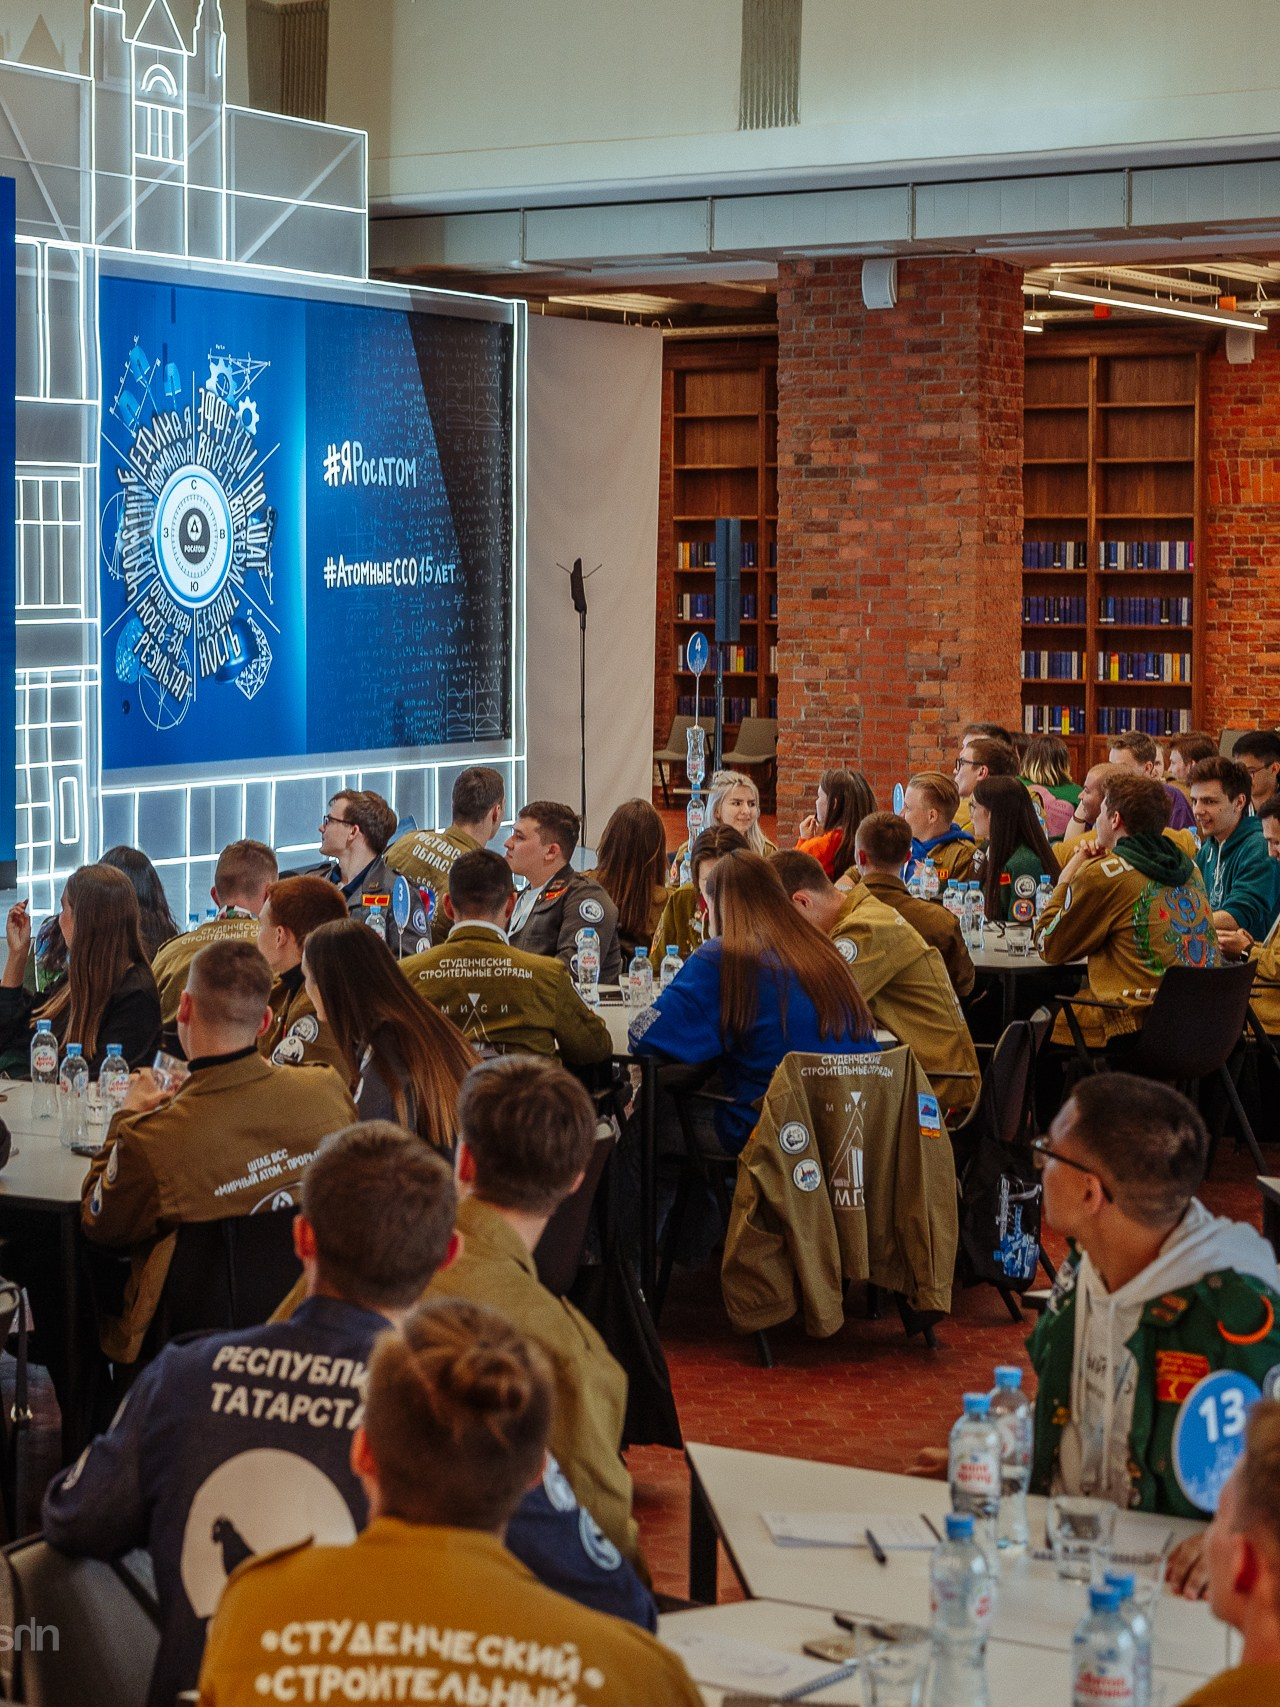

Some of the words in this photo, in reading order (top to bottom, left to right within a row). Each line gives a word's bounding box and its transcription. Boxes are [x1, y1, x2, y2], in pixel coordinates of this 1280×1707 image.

[129, 406, 193, 475] ЕДИНАЯ
[147, 438, 194, 493] КОМАНДА
[242, 471, 267, 517] НА
[229, 493, 247, 585] ВПЕРЕДИ
[246, 521, 269, 576] ШАГ
[195, 581, 240, 639] БЕЗОПАС
[134, 631, 193, 701] РЕЗУЛЬТАТ
[199, 624, 242, 677] НОСТЬ
[694, 637, 702, 652] 4
[412, 844, 453, 874] ОБЛАС
[414, 831, 462, 860] РОСТОВС
[398, 883, 404, 901] 3
[419, 967, 491, 980] СТРОИТЕЛЬНЫЕ
[494, 967, 533, 980] ОТРЯДЫ
[439, 957, 512, 968] СТУДЕНЧЕСКИЕ
[800, 1065, 867, 1076] СТРОИТЕЛЬНЫЕ
[821, 1054, 881, 1065] СТУДЕНЧЕСКИЕ
[247, 1154, 271, 1173] ШТАБ
[259, 1163, 283, 1182] АТОМ
[211, 1345, 370, 1390] РЕСПУБЛИ
[210, 1382, 368, 1430] ТАТАРСТА
[1198, 1388, 1247, 1443] 13
